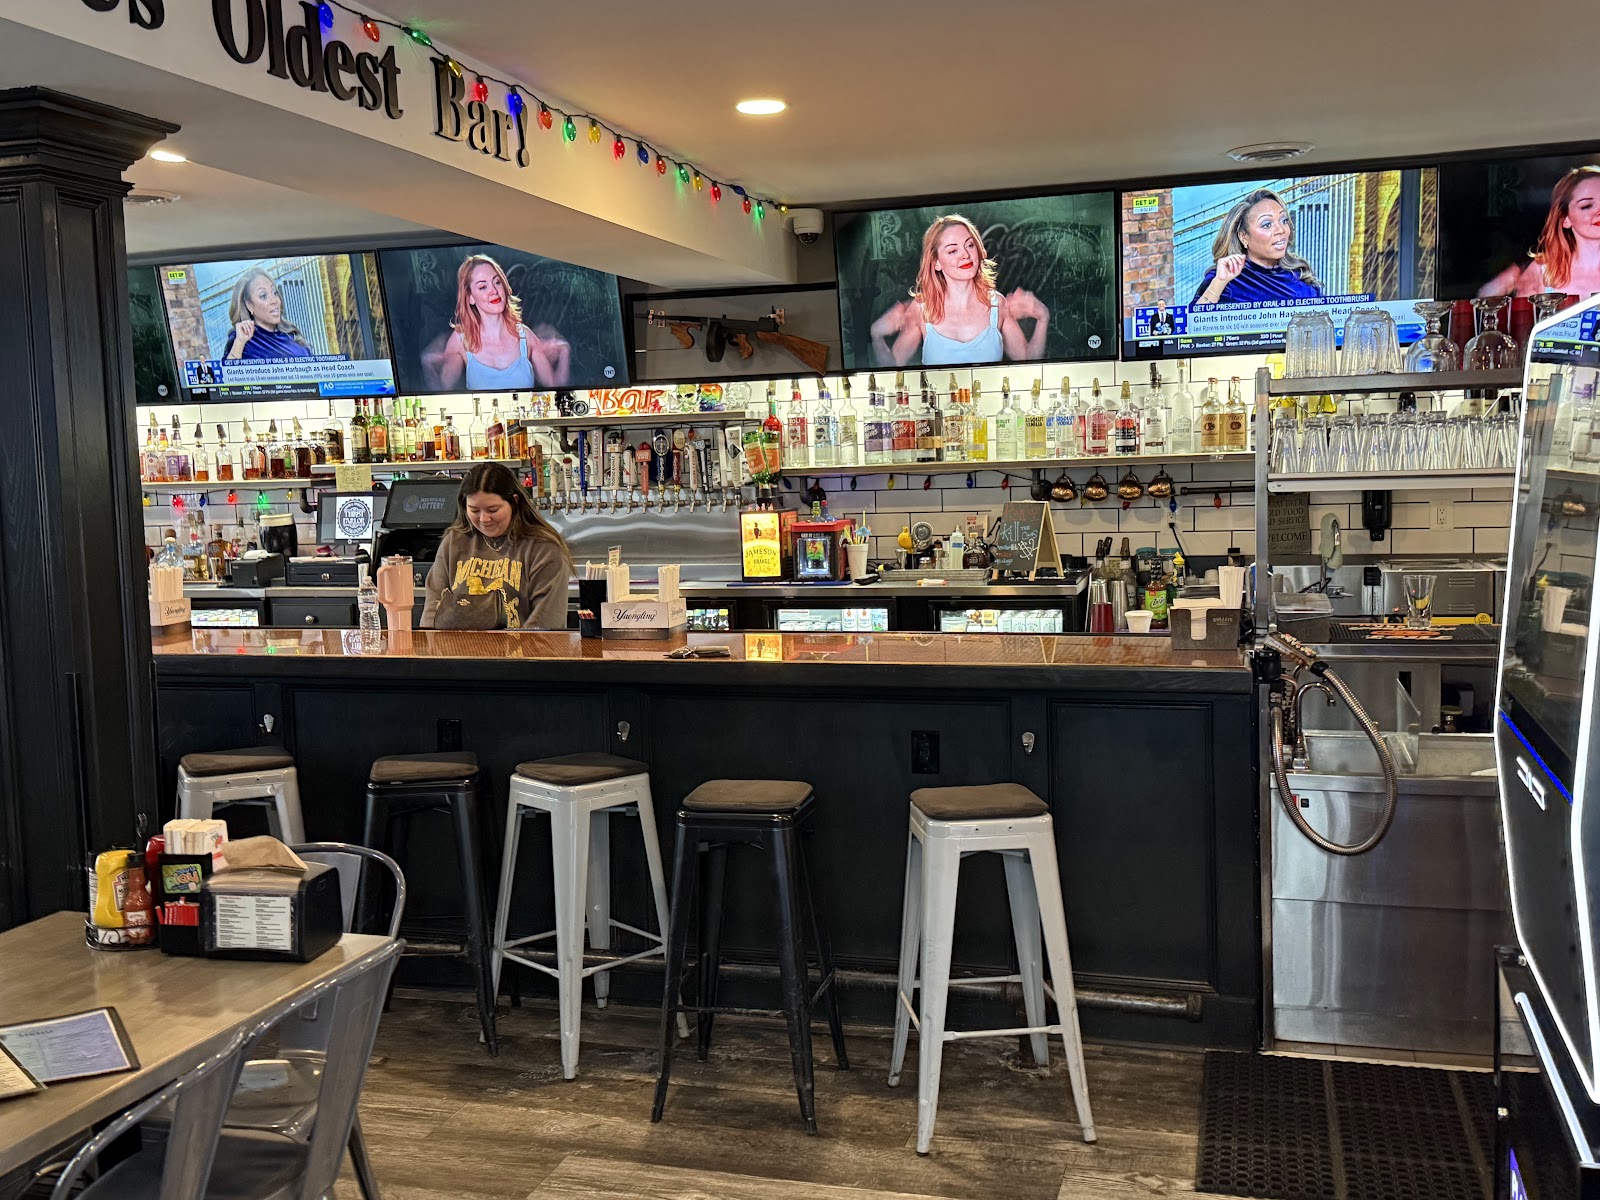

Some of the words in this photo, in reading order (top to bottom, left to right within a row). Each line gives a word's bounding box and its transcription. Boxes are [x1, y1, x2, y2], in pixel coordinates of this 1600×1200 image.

[212, 0, 403, 119] Oldest
[429, 56, 530, 168] Bar!
[1193, 304, 1205, 312] GET
[1216, 302, 1252, 311] PRESENTED
[1262, 299, 1286, 308] ORAL-B
[1295, 297, 1325, 306] ELECTRIC
[1326, 294, 1369, 304] TOOTHBRUSH
[1193, 315, 1218, 323] Giants
[1220, 313, 1257, 322] introduce
[1258, 311, 1277, 320] John
[226, 367, 244, 375] Giants
[245, 367, 271, 375] introduce
[272, 366, 285, 374] John
[285, 365, 312, 374] Harbaugh
[418, 502, 445, 510] LOTTERY
[1277, 516, 1307, 526] SERVICE
[1000, 521, 1019, 541] Kill
[745, 547, 777, 558] JAMESON
[612, 608, 658, 623] Yuengling
